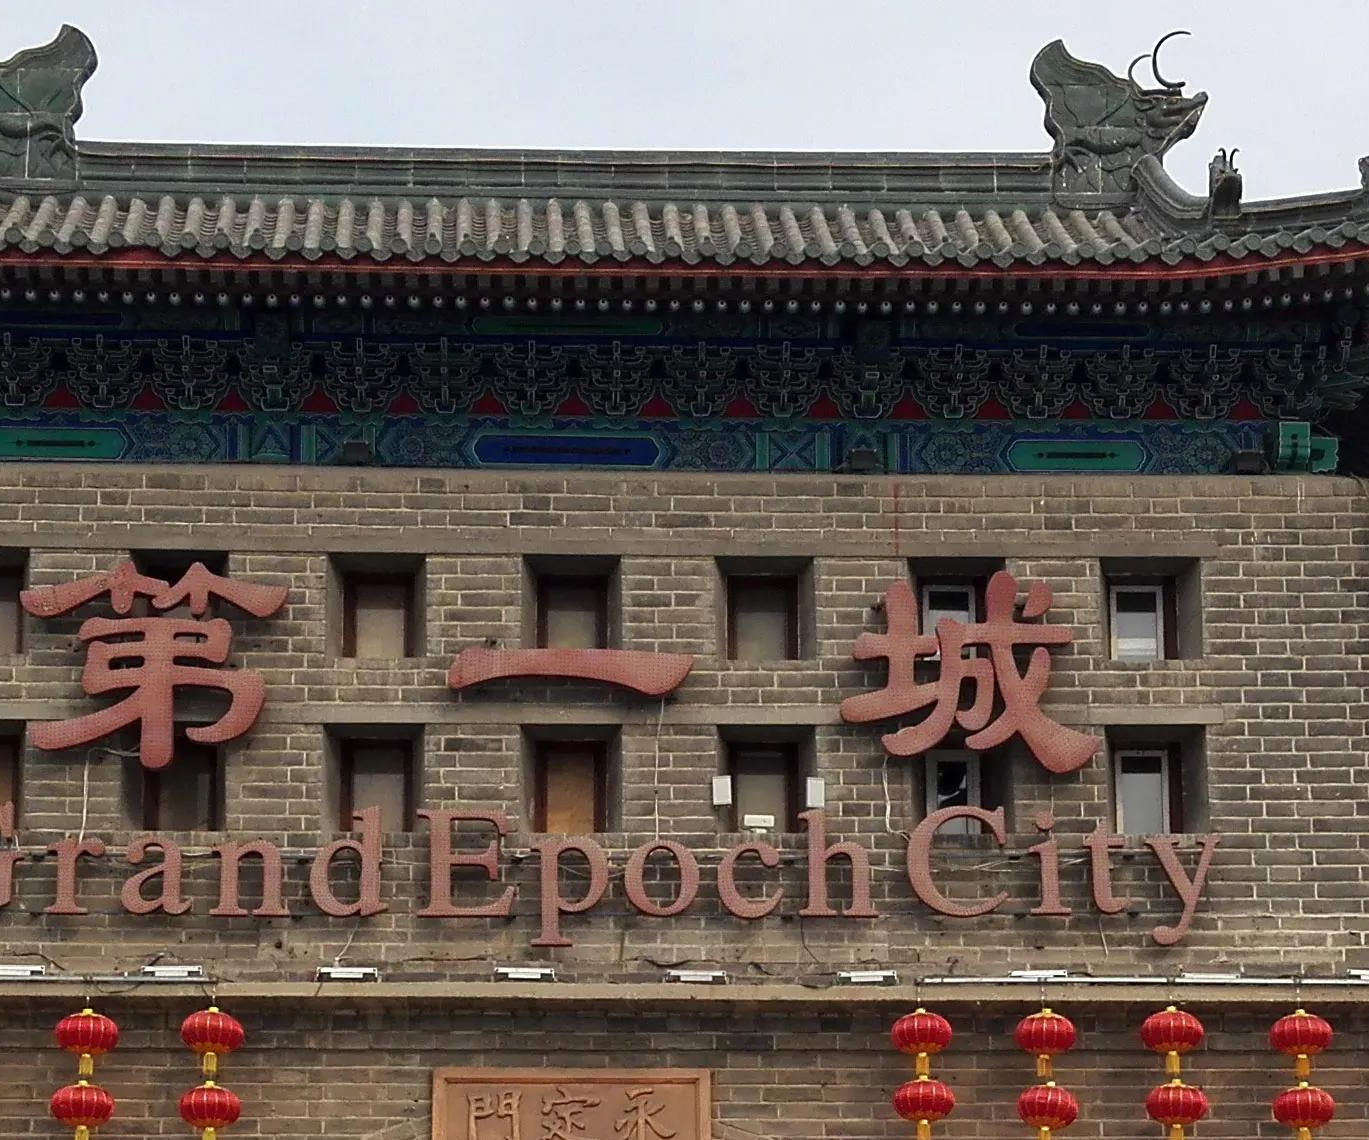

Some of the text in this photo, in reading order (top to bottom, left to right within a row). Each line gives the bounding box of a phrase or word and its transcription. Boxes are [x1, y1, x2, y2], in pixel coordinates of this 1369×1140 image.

[20, 562, 1099, 774] 第一城
[417, 808, 879, 948] Epoch
[906, 805, 1220, 946] City
